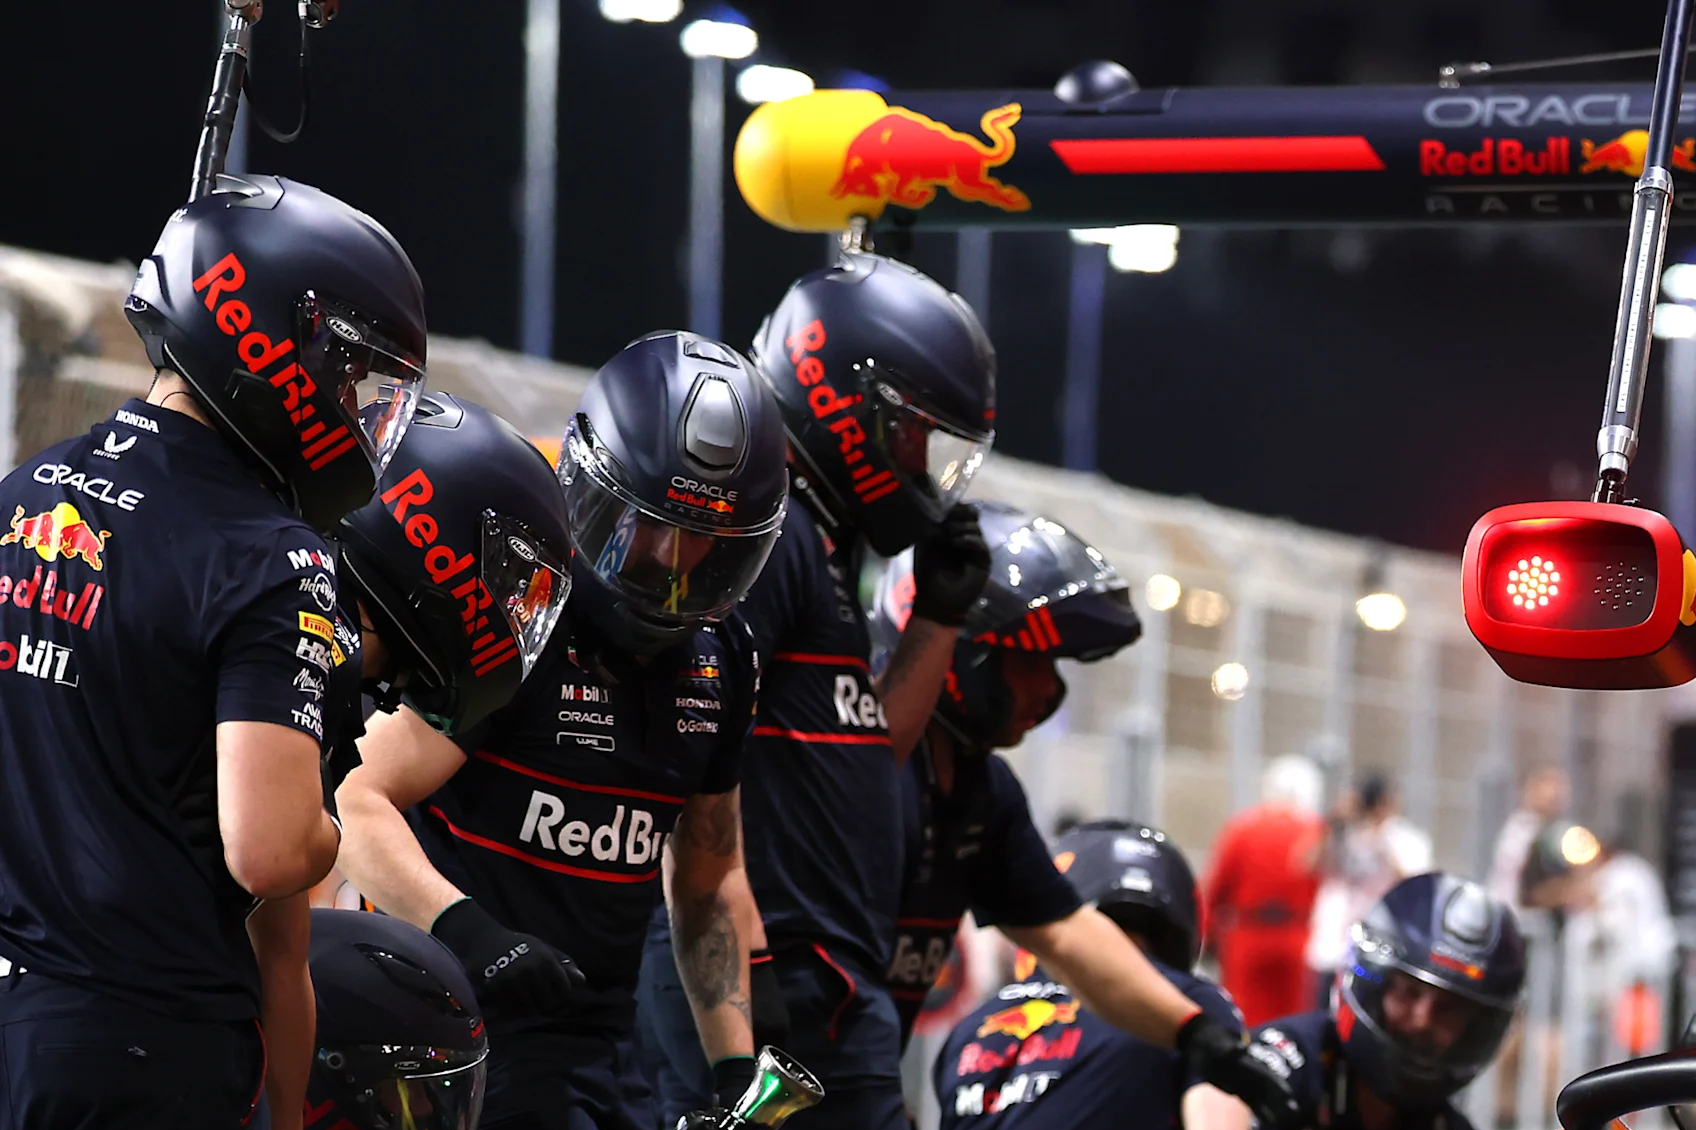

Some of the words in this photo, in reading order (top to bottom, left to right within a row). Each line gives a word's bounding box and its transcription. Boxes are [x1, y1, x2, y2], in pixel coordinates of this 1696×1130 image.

[329, 318, 360, 342] HJC
[115, 410, 160, 434] HONDA
[33, 463, 146, 511] ORACLE
[671, 476, 739, 502] ORACLE
[663, 502, 731, 525] RACING
[510, 538, 535, 560] HJC
[286, 548, 336, 576] Mobil
[0, 565, 43, 609] ed
[0, 634, 53, 680] obil
[561, 684, 600, 702] Mobil
[676, 698, 721, 711] HONDA
[558, 711, 614, 726] ORACLE
